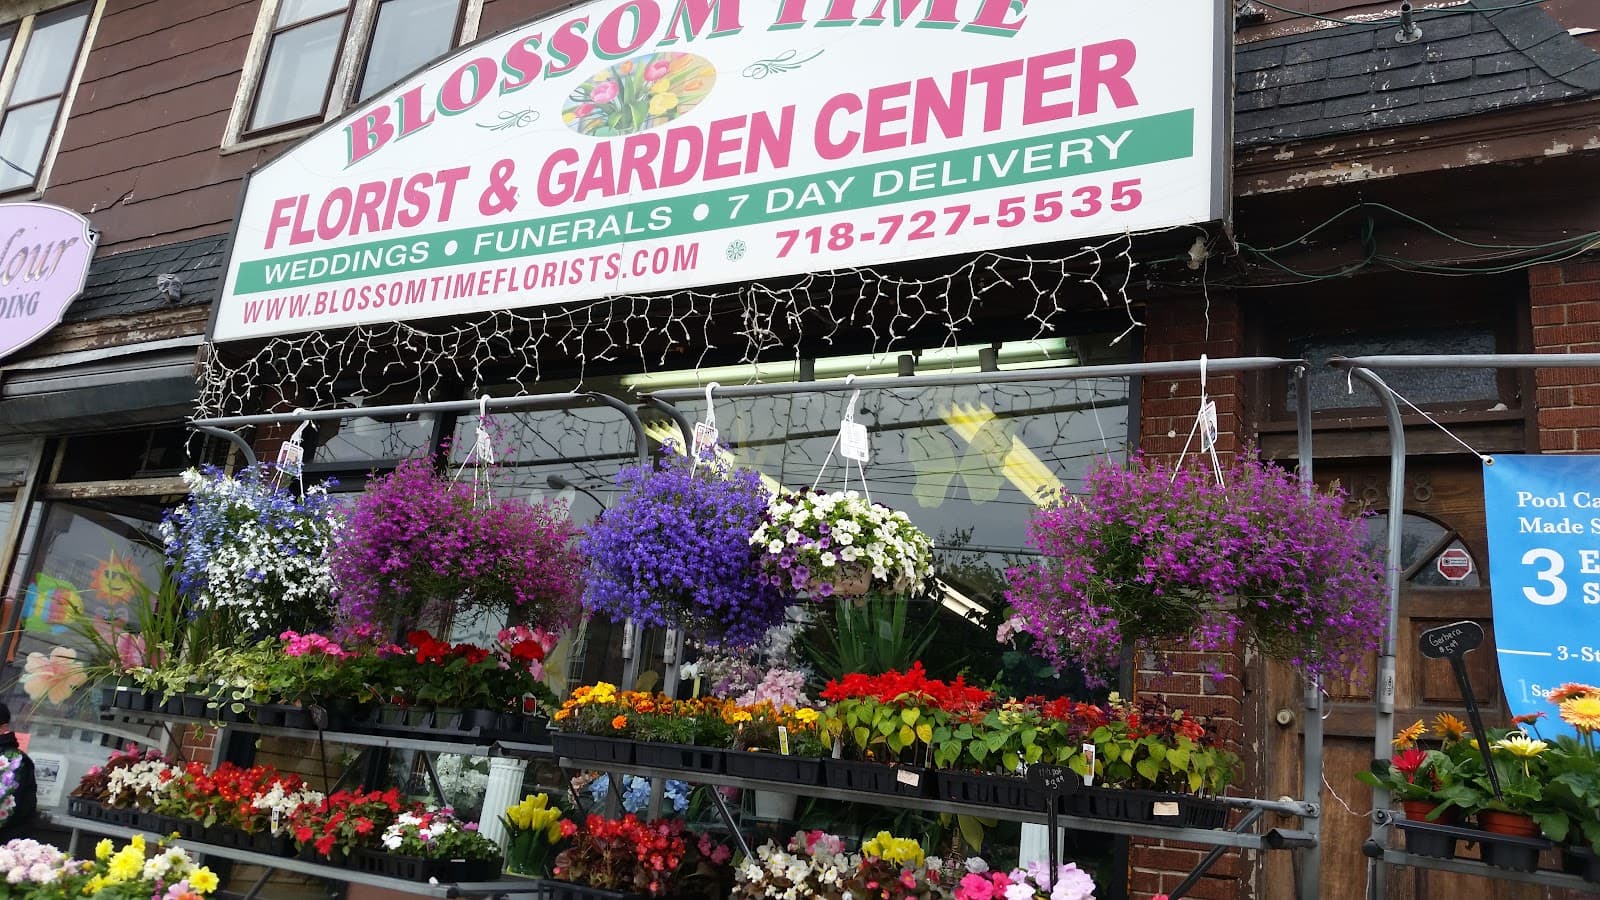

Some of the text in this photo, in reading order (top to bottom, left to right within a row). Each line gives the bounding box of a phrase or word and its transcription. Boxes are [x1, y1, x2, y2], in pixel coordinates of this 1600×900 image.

[343, 0, 743, 169] BLOSSOM
[265, 39, 1138, 249] FLORIST & GARDEN CENTER
[265, 130, 1133, 284] WEDDINGS FUNERALS 7 DAY DELIVERY
[243, 178, 1142, 324] WWW.BLOSSOMTIMEFLORISTS.COM 718-727-5535
[1516, 491, 1600, 508] Pool Ca
[1519, 517, 1584, 534] Made
[1521, 547, 1600, 606] 3 E
[1582, 582, 1600, 605] S
[1428, 628, 1464, 647] Gerbera
